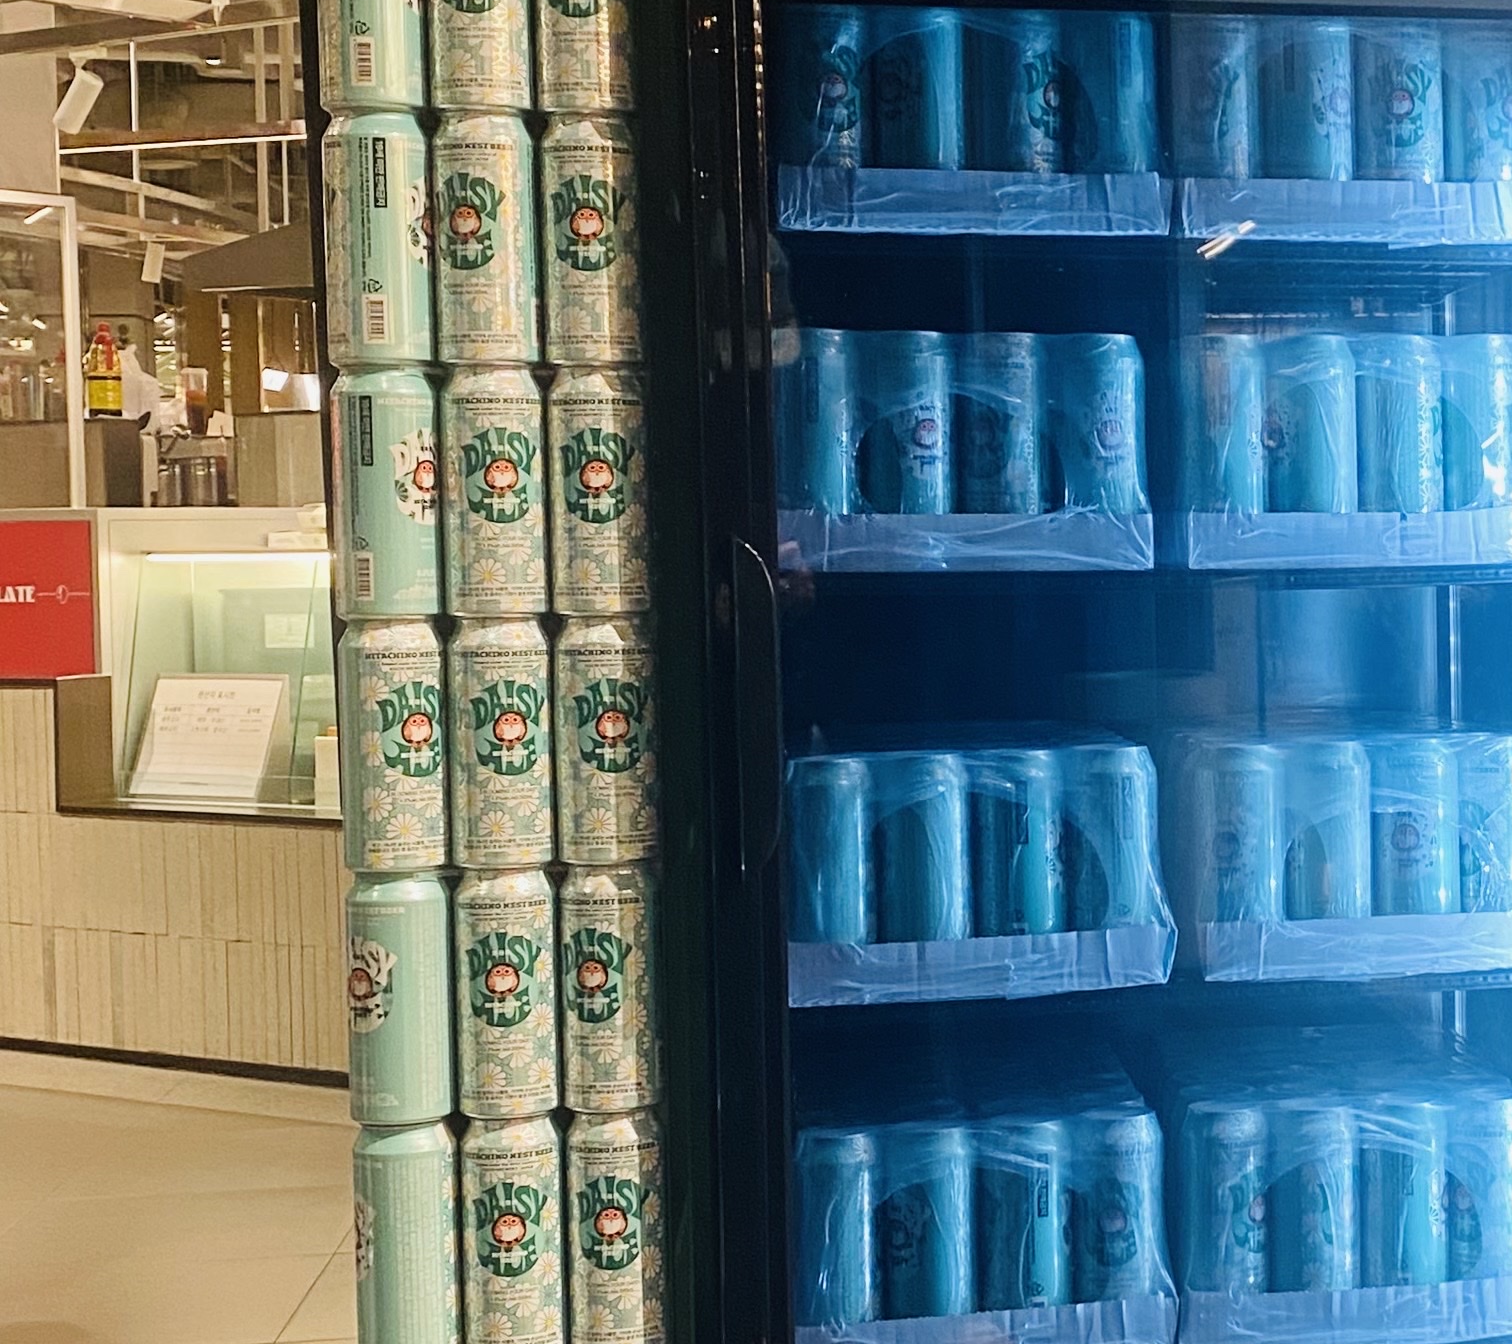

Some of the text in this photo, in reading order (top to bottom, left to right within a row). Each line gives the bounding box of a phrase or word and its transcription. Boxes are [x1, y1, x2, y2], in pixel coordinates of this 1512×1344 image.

[461, 428, 537, 478] DAISY
[559, 428, 636, 478] DAISY
[470, 680, 545, 730] DAISY
[466, 932, 542, 979] DAISY
[472, 1182, 547, 1231] DAISY
[576, 1176, 650, 1225] DAISY
